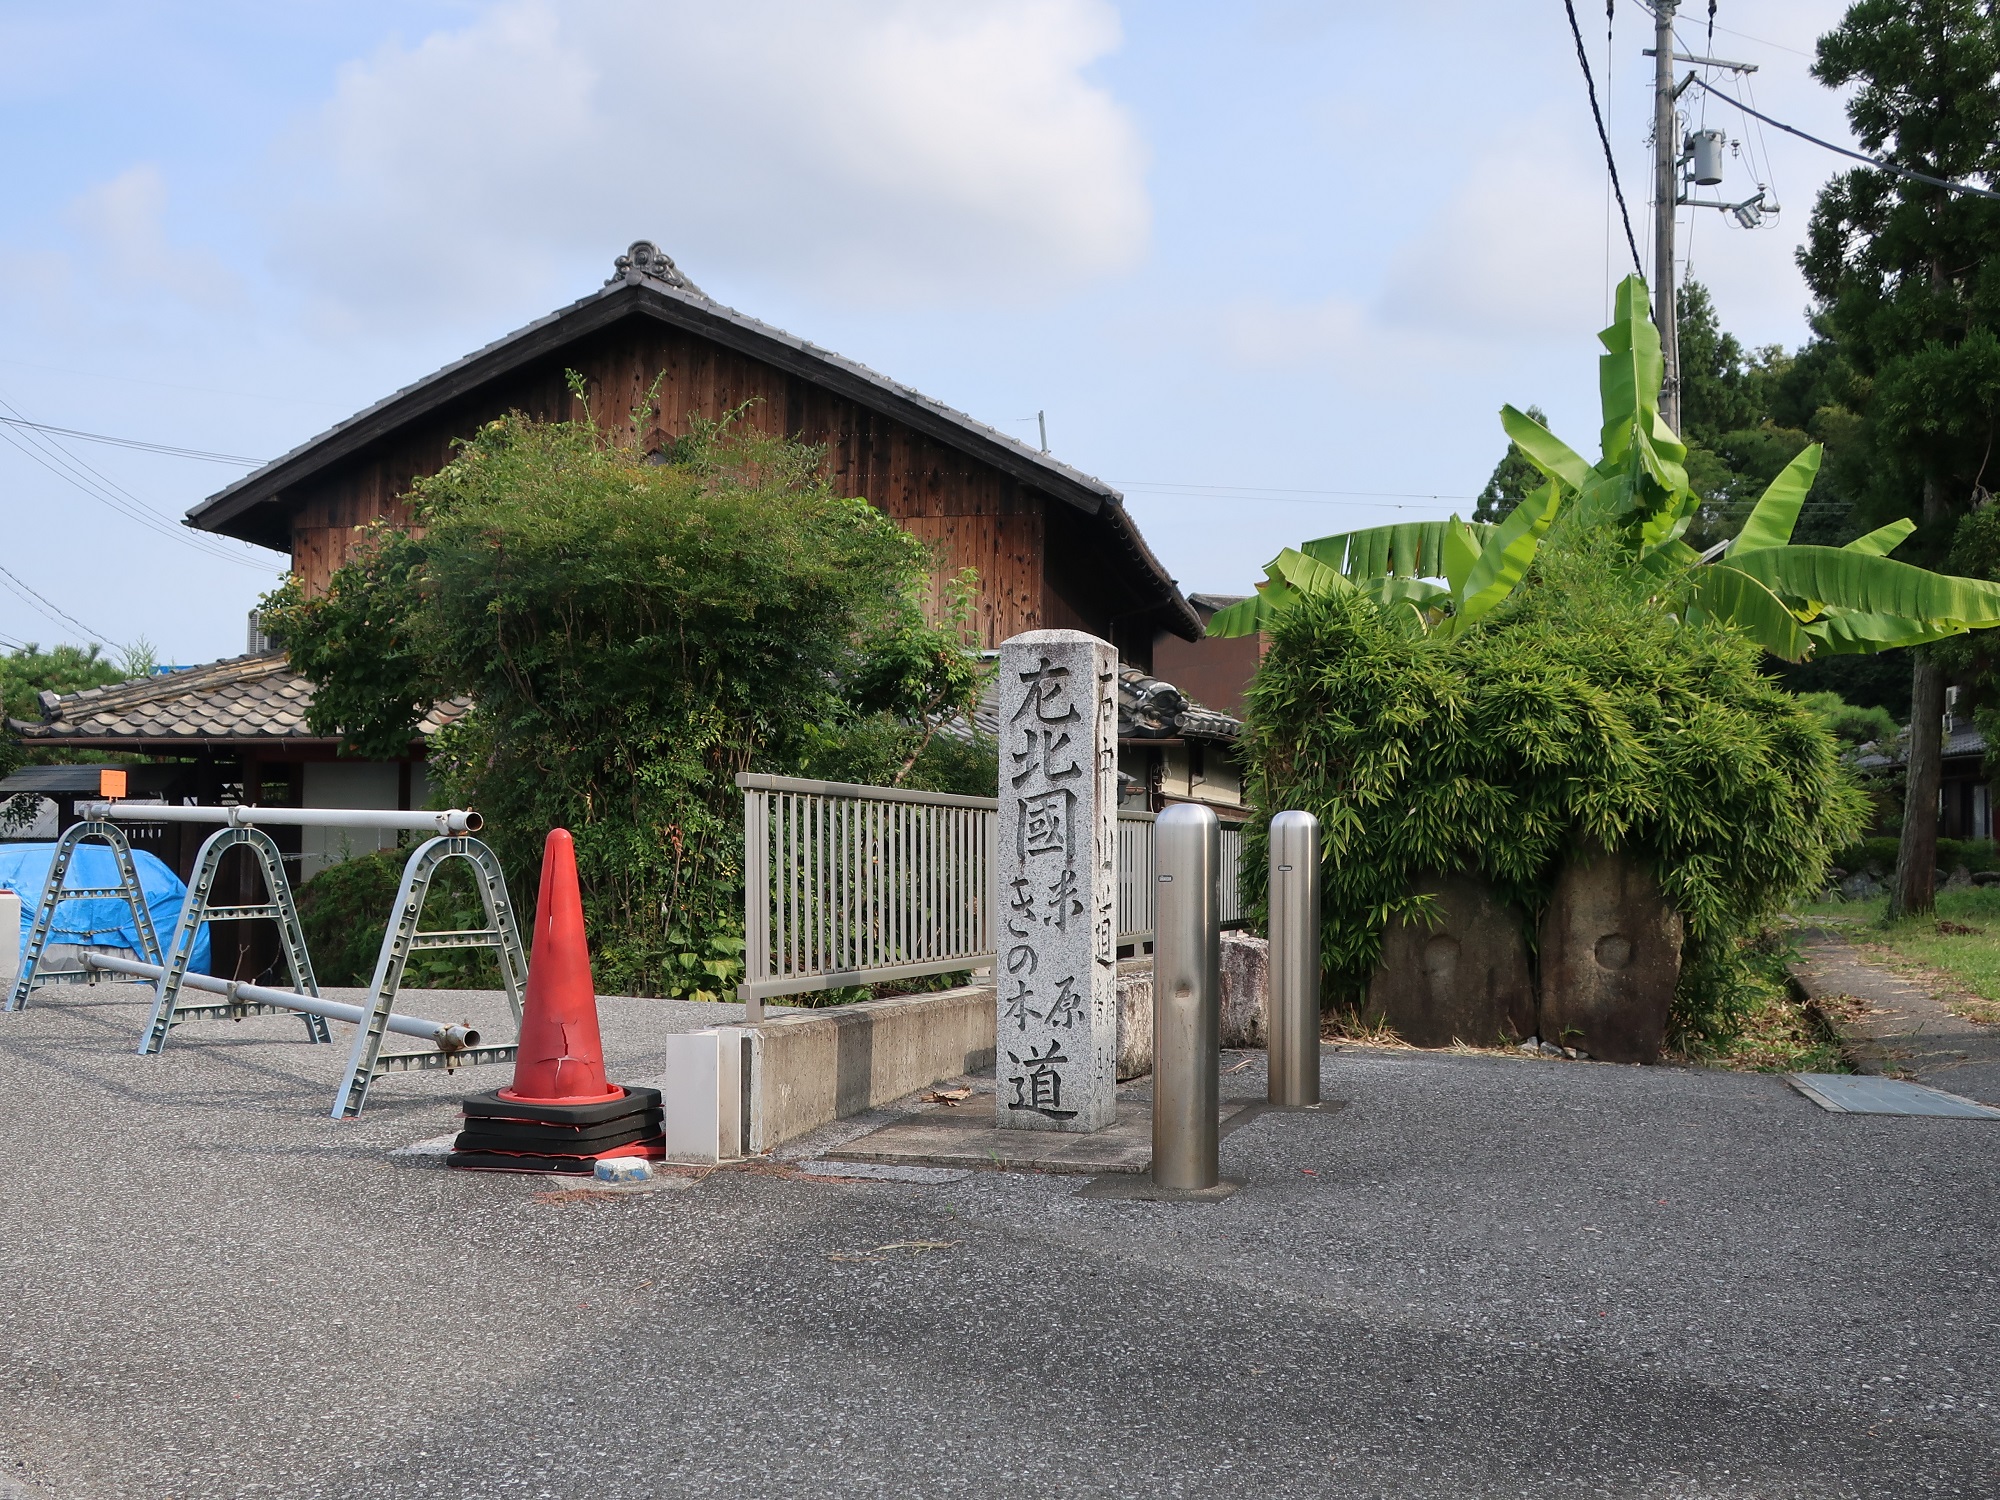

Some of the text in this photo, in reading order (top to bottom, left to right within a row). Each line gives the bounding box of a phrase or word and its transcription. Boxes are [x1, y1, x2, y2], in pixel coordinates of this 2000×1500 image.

[1004, 877, 1042, 1031] きの本
[1044, 869, 1086, 1030] 米原
[1008, 1039, 1079, 1121] 道
